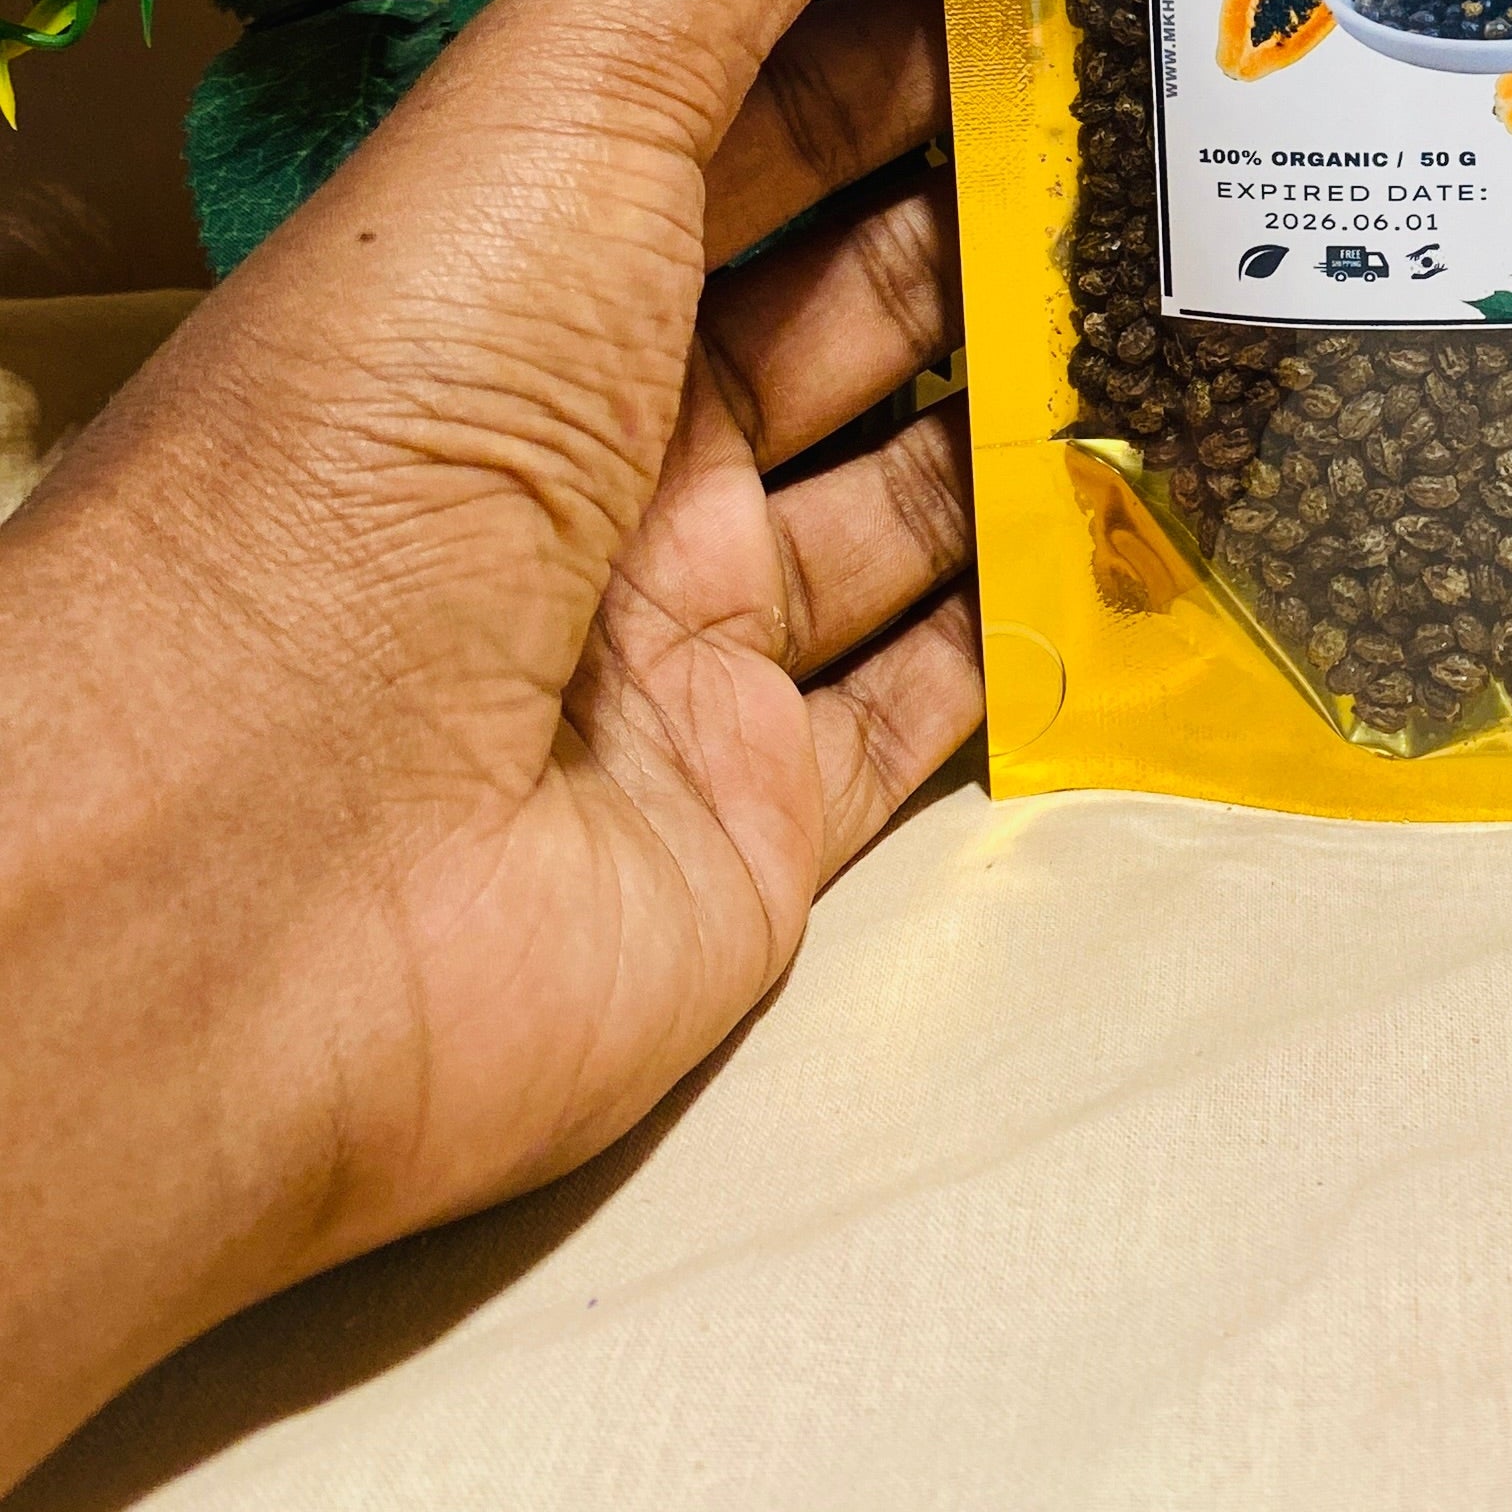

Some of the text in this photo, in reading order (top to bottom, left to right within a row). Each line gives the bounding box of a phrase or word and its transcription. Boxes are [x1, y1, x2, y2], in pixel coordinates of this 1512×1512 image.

[1198, 148, 1477, 168] 100% ORGANIC / 50 G
[1217, 181, 1488, 202] EXPIRED DATE:
[1264, 212, 1439, 231] 2026.06.01
[1331, 260, 1362, 268] SHIPPING
[1340, 249, 1361, 260] FREE
